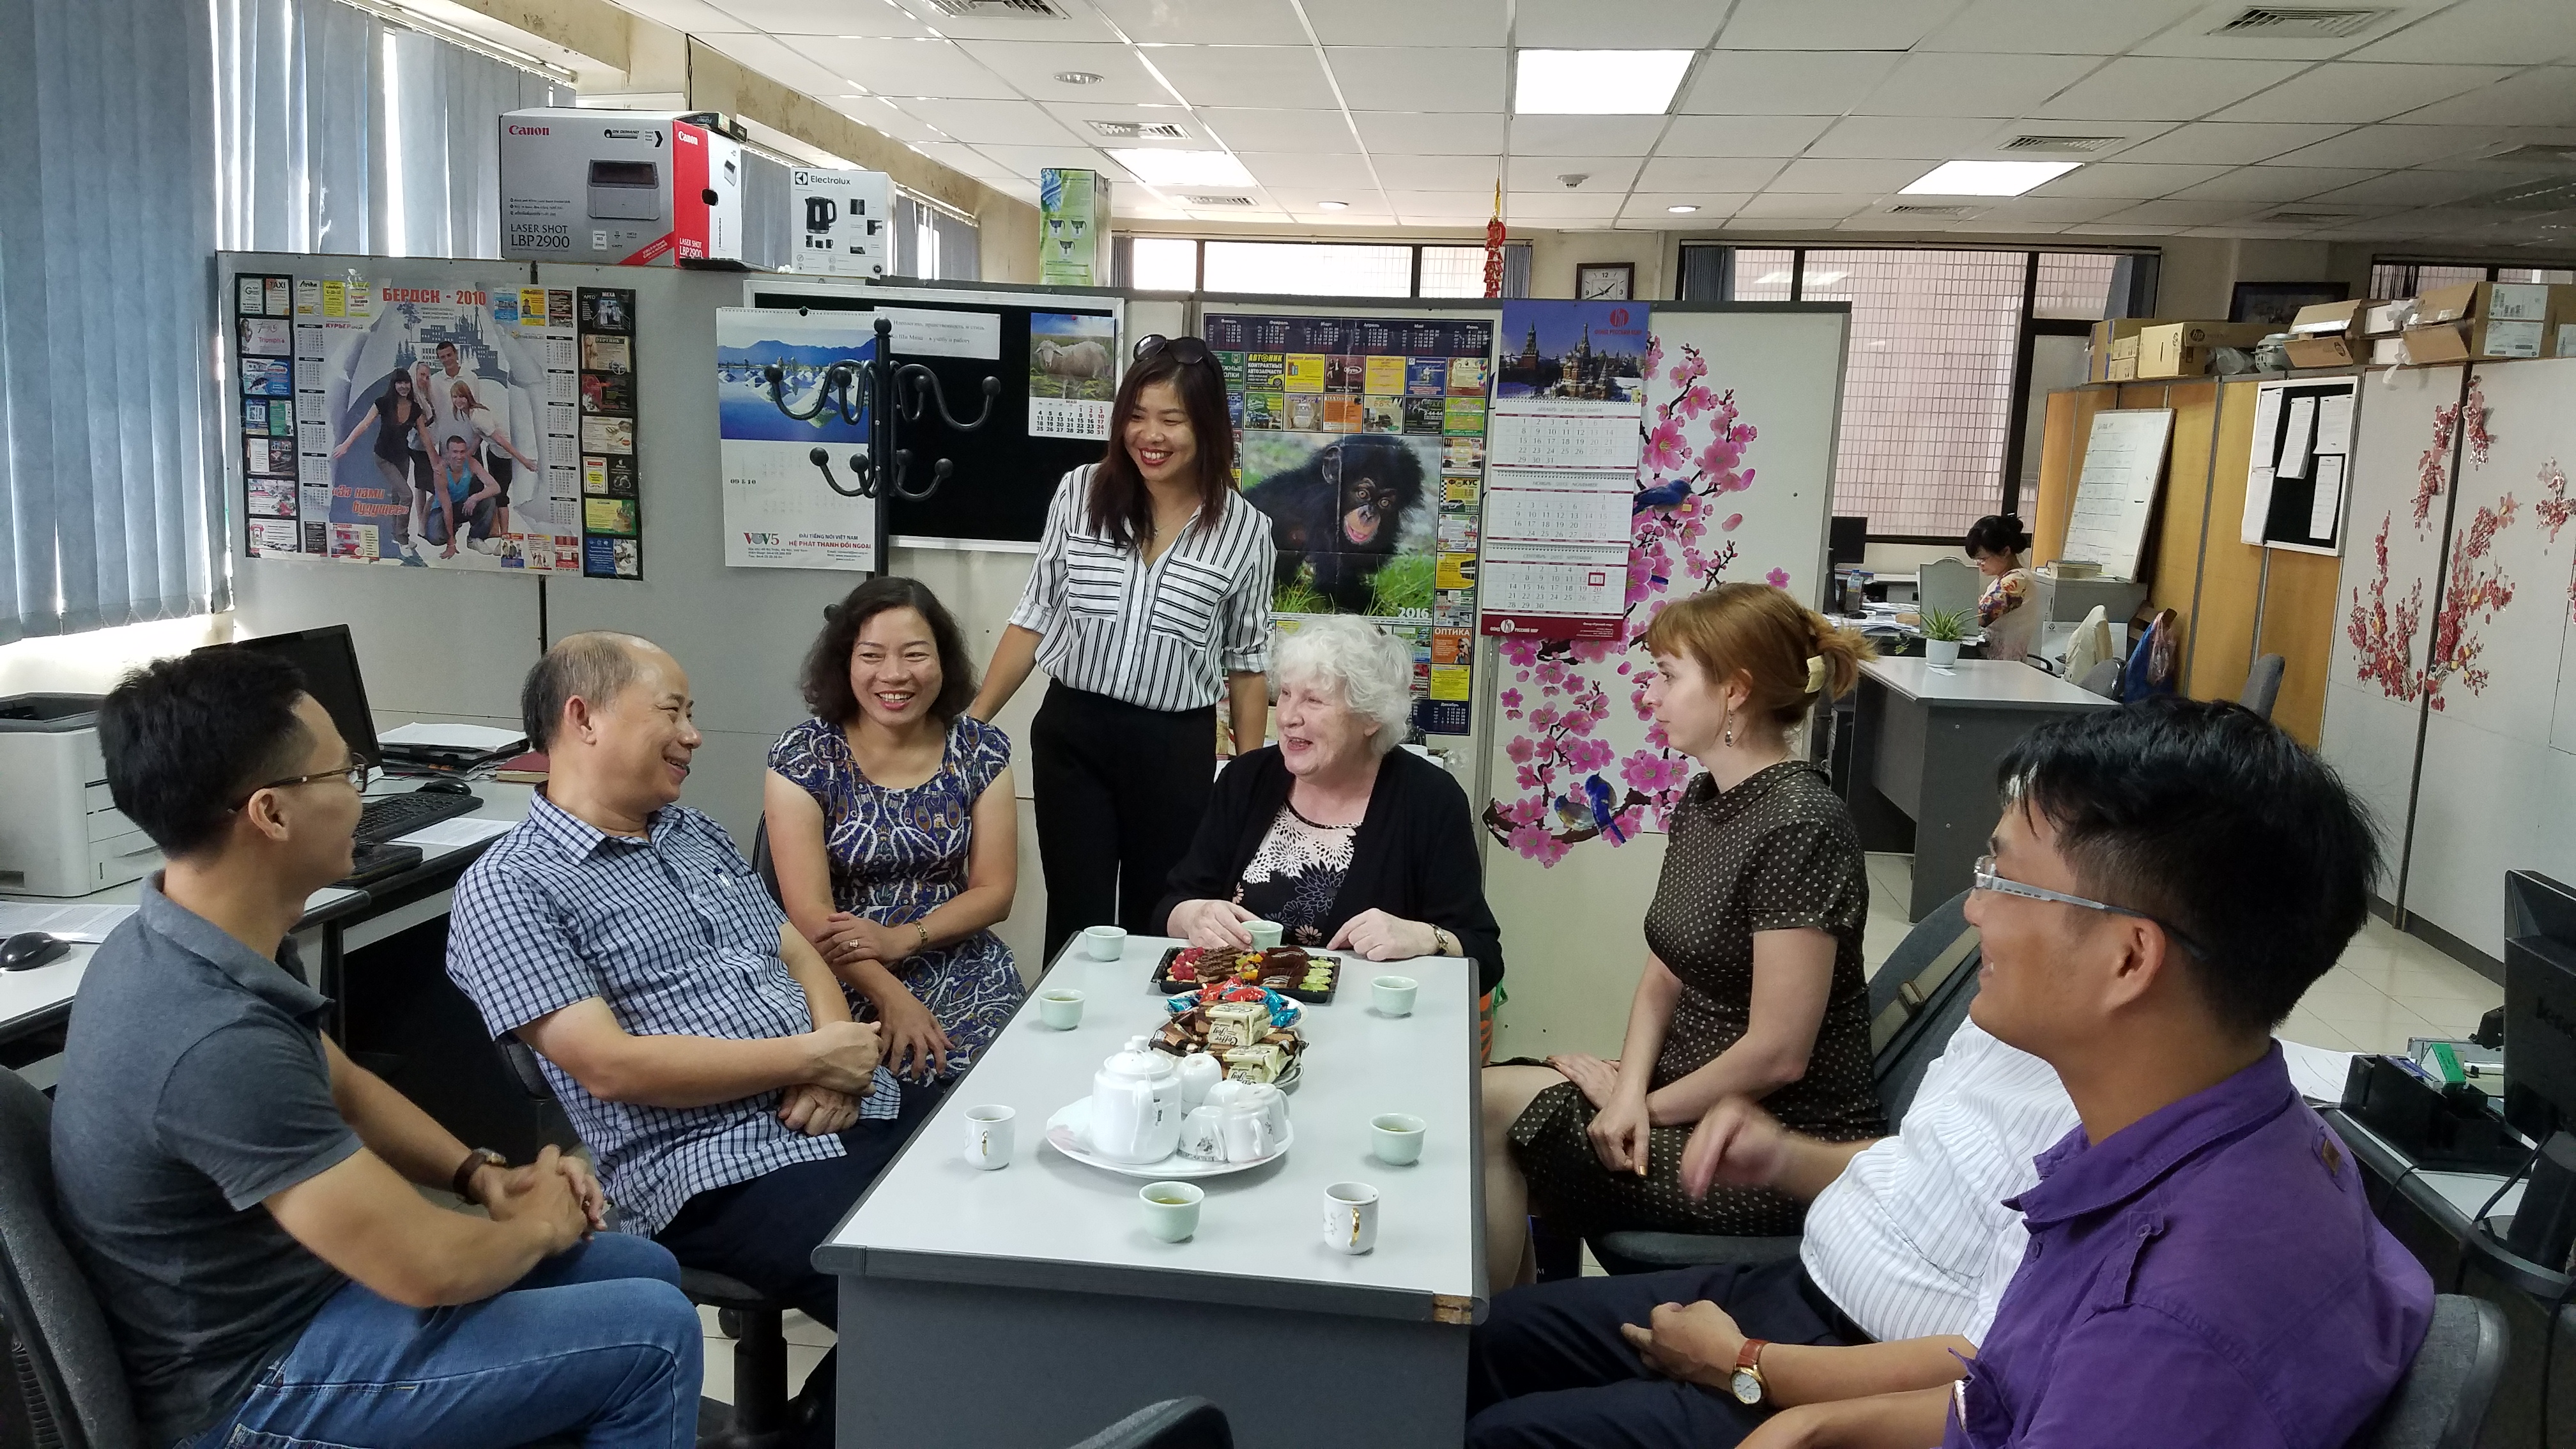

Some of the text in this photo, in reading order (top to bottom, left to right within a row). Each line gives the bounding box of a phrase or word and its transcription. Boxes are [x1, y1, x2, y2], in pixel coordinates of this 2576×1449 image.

[509, 125, 549, 136] Canon
[678, 130, 698, 146] Canon
[811, 176, 851, 185] Electrolux
[511, 224, 568, 234] LASER SHOT
[511, 234, 570, 249] LBP2900
[680, 245, 702, 258] LBP2900
[383, 288, 440, 303] БЕРДСК
[456, 290, 486, 305] 2010
[355, 487, 385, 499] нами
[744, 532, 780, 546] VOV5
[1398, 608, 1429, 618] 2016
[1212, 1027, 1227, 1036] Joy
[1215, 1036, 1238, 1046] Coffee
[1230, 1072, 1246, 1082] Joy
